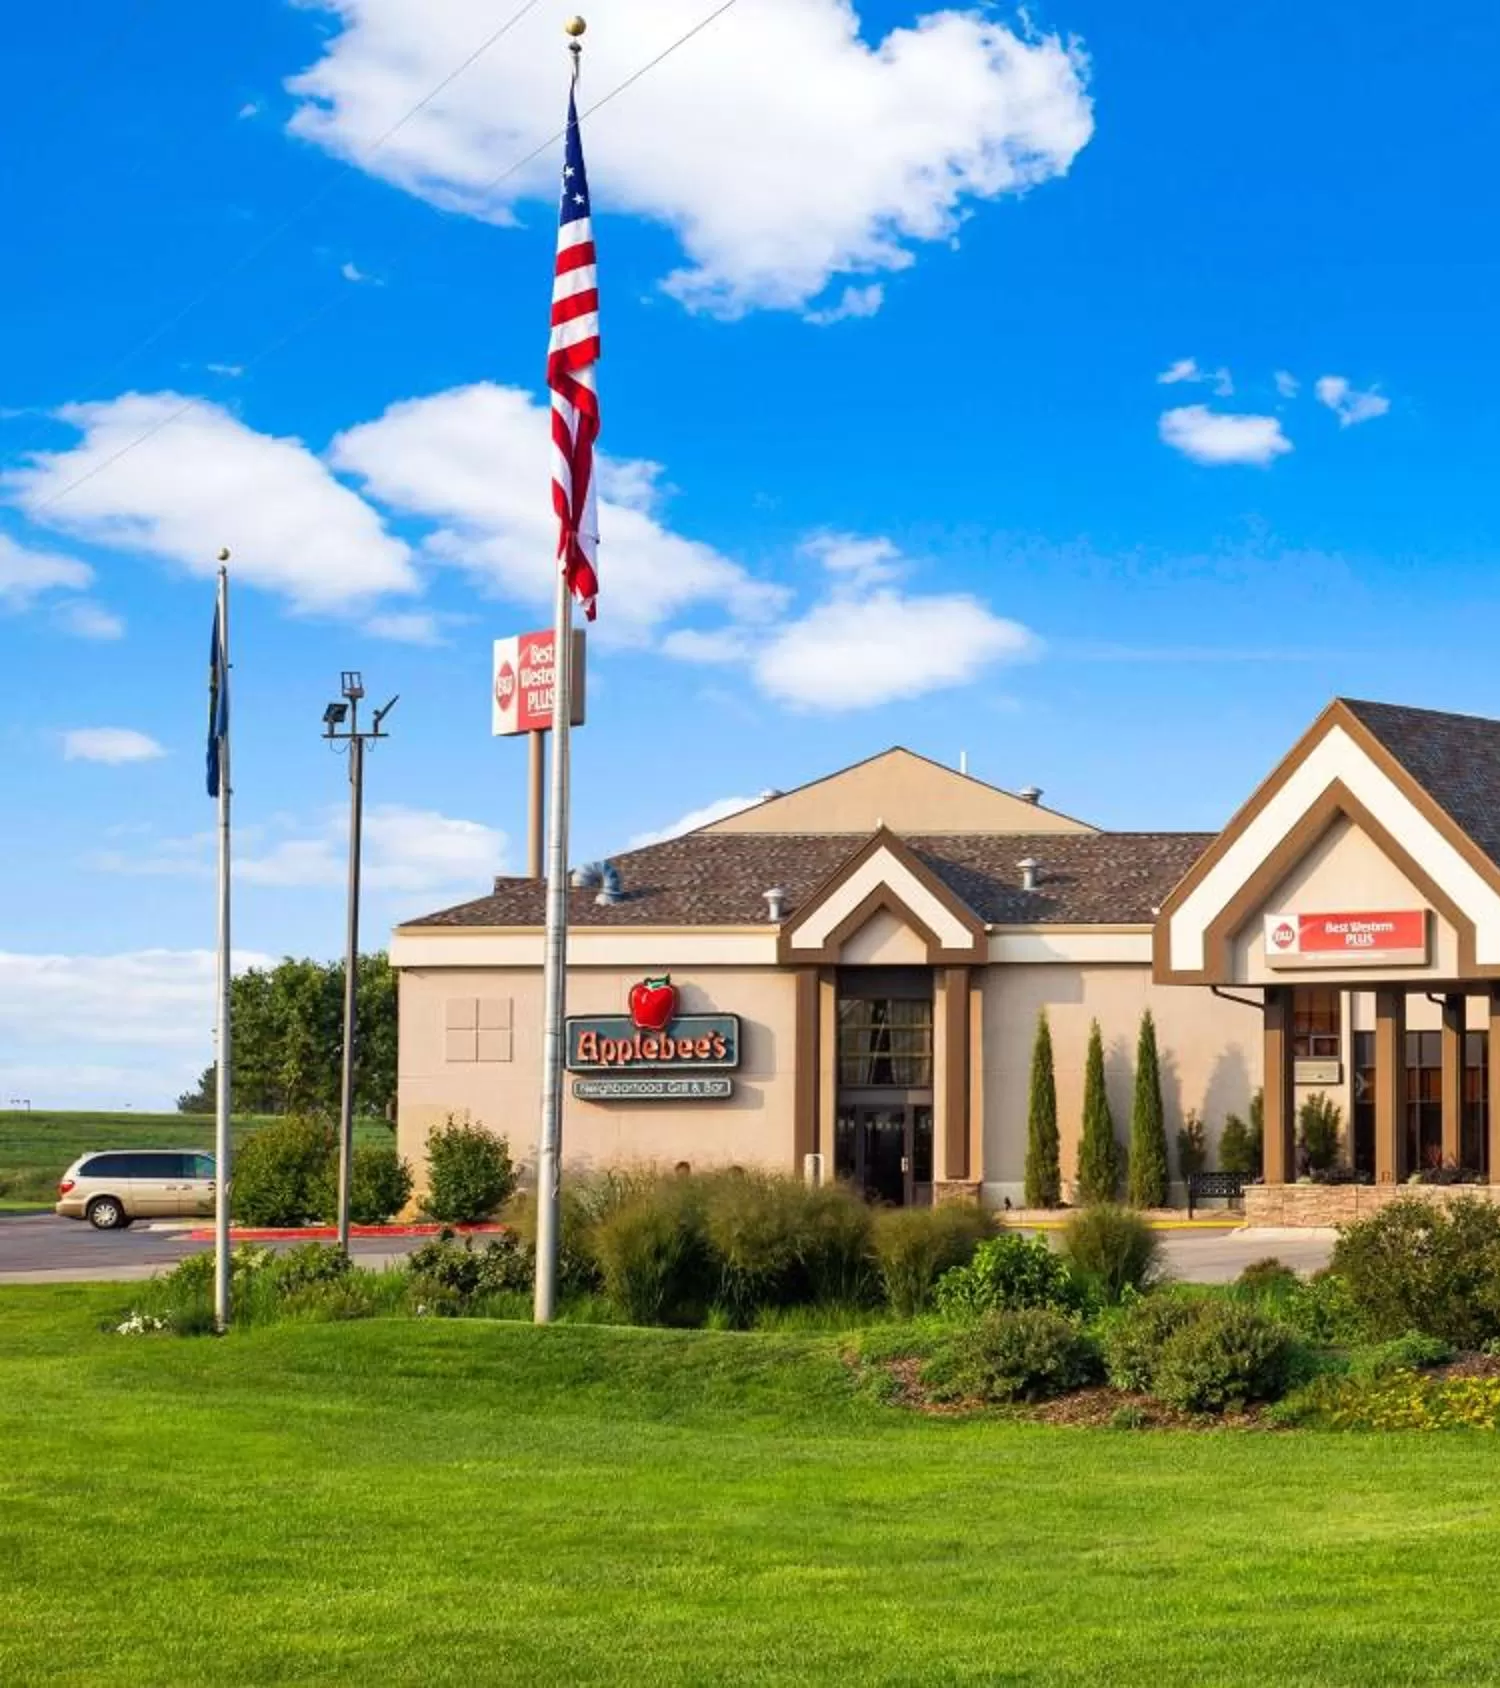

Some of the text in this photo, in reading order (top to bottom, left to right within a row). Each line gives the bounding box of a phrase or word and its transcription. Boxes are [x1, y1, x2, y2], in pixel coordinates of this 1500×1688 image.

[1325, 921, 1394, 933] Best Western
[1345, 933, 1374, 945] PLUS
[576, 1030, 727, 1065] Applebee's
[668, 1081, 689, 1093] Grill
[703, 1081, 724, 1093] Bar
